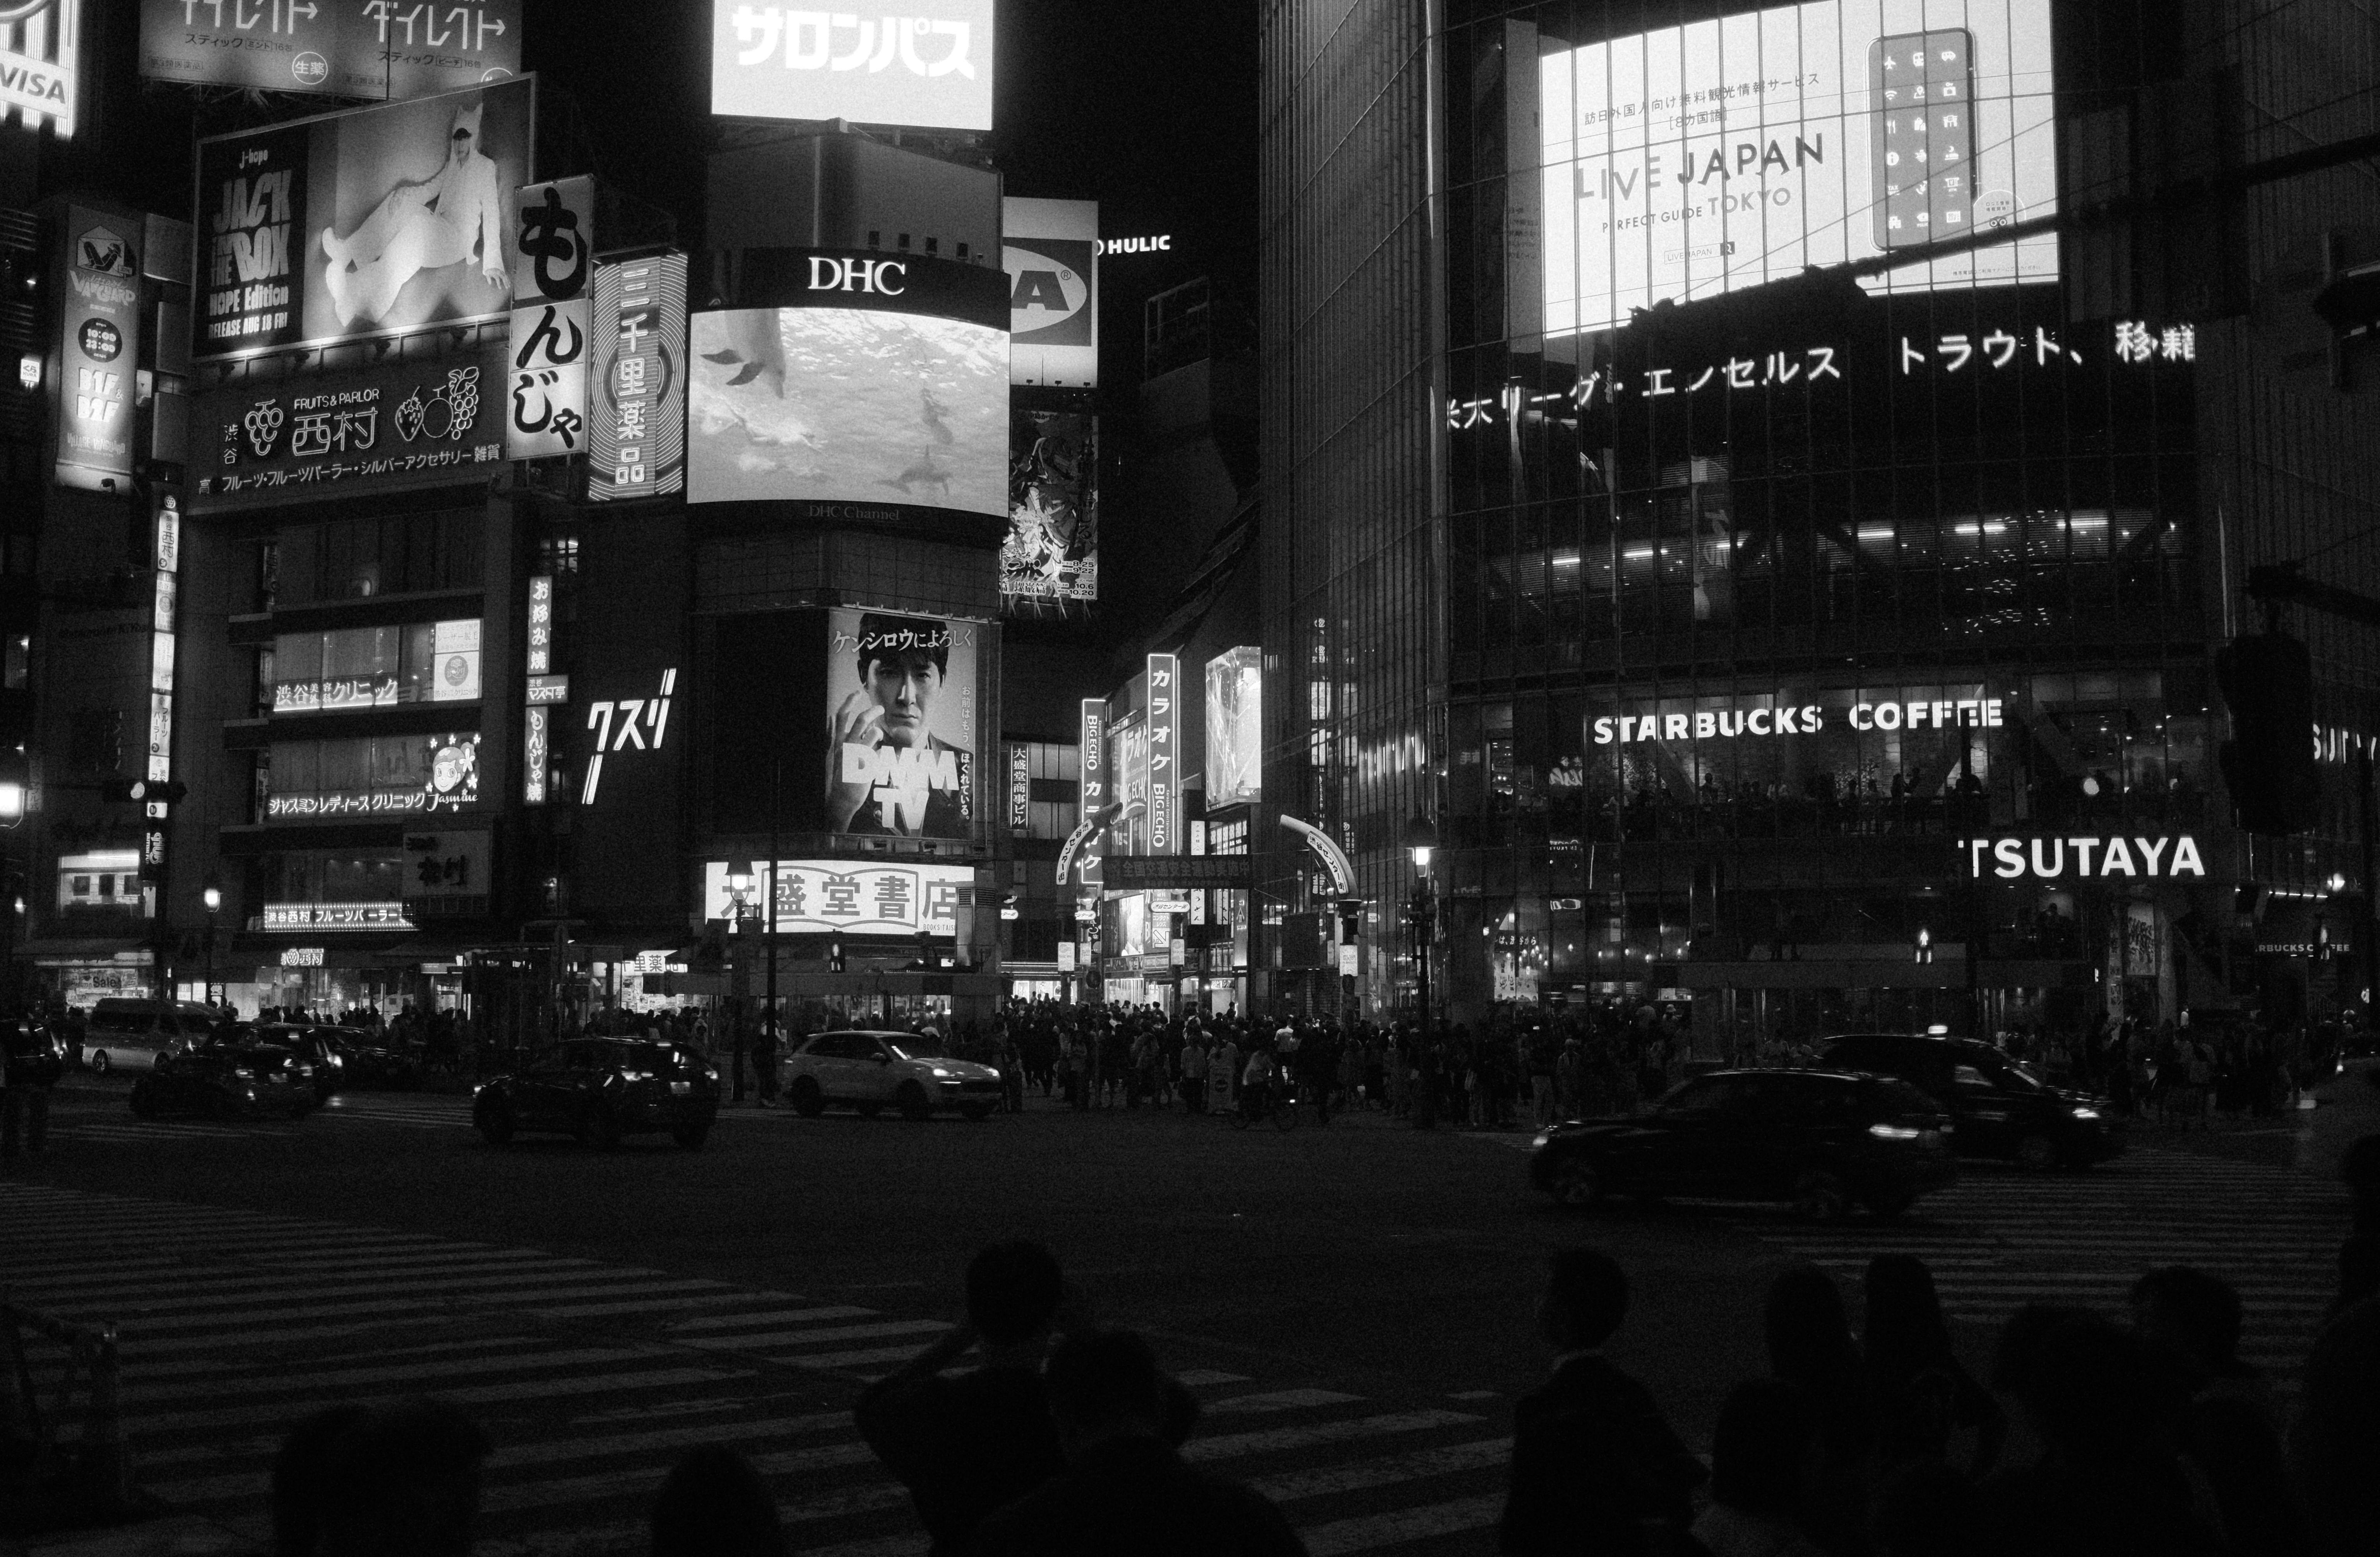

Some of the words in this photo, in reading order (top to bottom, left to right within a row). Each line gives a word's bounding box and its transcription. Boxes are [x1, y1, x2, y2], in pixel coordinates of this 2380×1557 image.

[185, 34, 243, 48] スティック
[247, 41, 270, 49] ミント
[378, 51, 434, 65] スティック
[732, 5, 975, 80] サロンパス
[0, 63, 66, 104] VISA
[295, 61, 325, 75] 生薬
[240, 149, 269, 169] j-hope
[1577, 156, 1661, 200] LIVE
[1677, 133, 1823, 185] JAPAN
[213, 170, 292, 232] JACK
[1603, 214, 1656, 233] PRFECT
[1661, 207, 1702, 222] GUIDE
[1708, 188, 1791, 216] TOKYO
[234, 223, 290, 282] BOX
[1107, 235, 1171, 256] HULIC
[1668, 252, 1684, 261] LIVE
[808, 256, 906, 296] DHC
[1011, 270, 1070, 311] A
[244, 285, 289, 310] Edition
[87, 328, 116, 342] 10:00
[209, 317, 241, 339] RELEASE
[243, 315, 260, 334] AUG
[262, 314, 272, 332] 18
[274, 312, 288, 330] FRI
[513, 186, 587, 449] もんじゃ
[79, 367, 120, 395] B1F
[615, 268, 650, 485] 三千里薬品
[223, 424, 238, 464] 渋谷
[293, 407, 378, 457] 西村
[809, 505, 841, 517] DHC
[844, 505, 900, 520] Channel
[832, 628, 972, 653] ケンシロウによろしく
[1087, 715, 1098, 737] BIG
[1151, 670, 1171, 771] カラオケ
[1594, 705, 1823, 744] STARBUCKS
[1848, 699, 2003, 730] COFFEE
[842, 742, 959, 790] DMM
[1087, 739, 1098, 770] ECHO
[426, 792, 478, 812] Jasmine
[1012, 747, 1026, 826] 大盛堂商事ビル
[1153, 784, 1165, 808] BIG
[873, 787, 929, 829] TV
[1153, 811, 1165, 848] ECHO
[1058, 823, 1089, 883] 渋谷センター街
[1957, 837, 2205, 878] TSUTAYA
[268, 911, 310, 922] 渋谷西村
[315, 909, 397, 922] フルーツパーラー
[2255, 944, 2305, 952] RBUCKS
[93, 976, 116, 987] Sale
